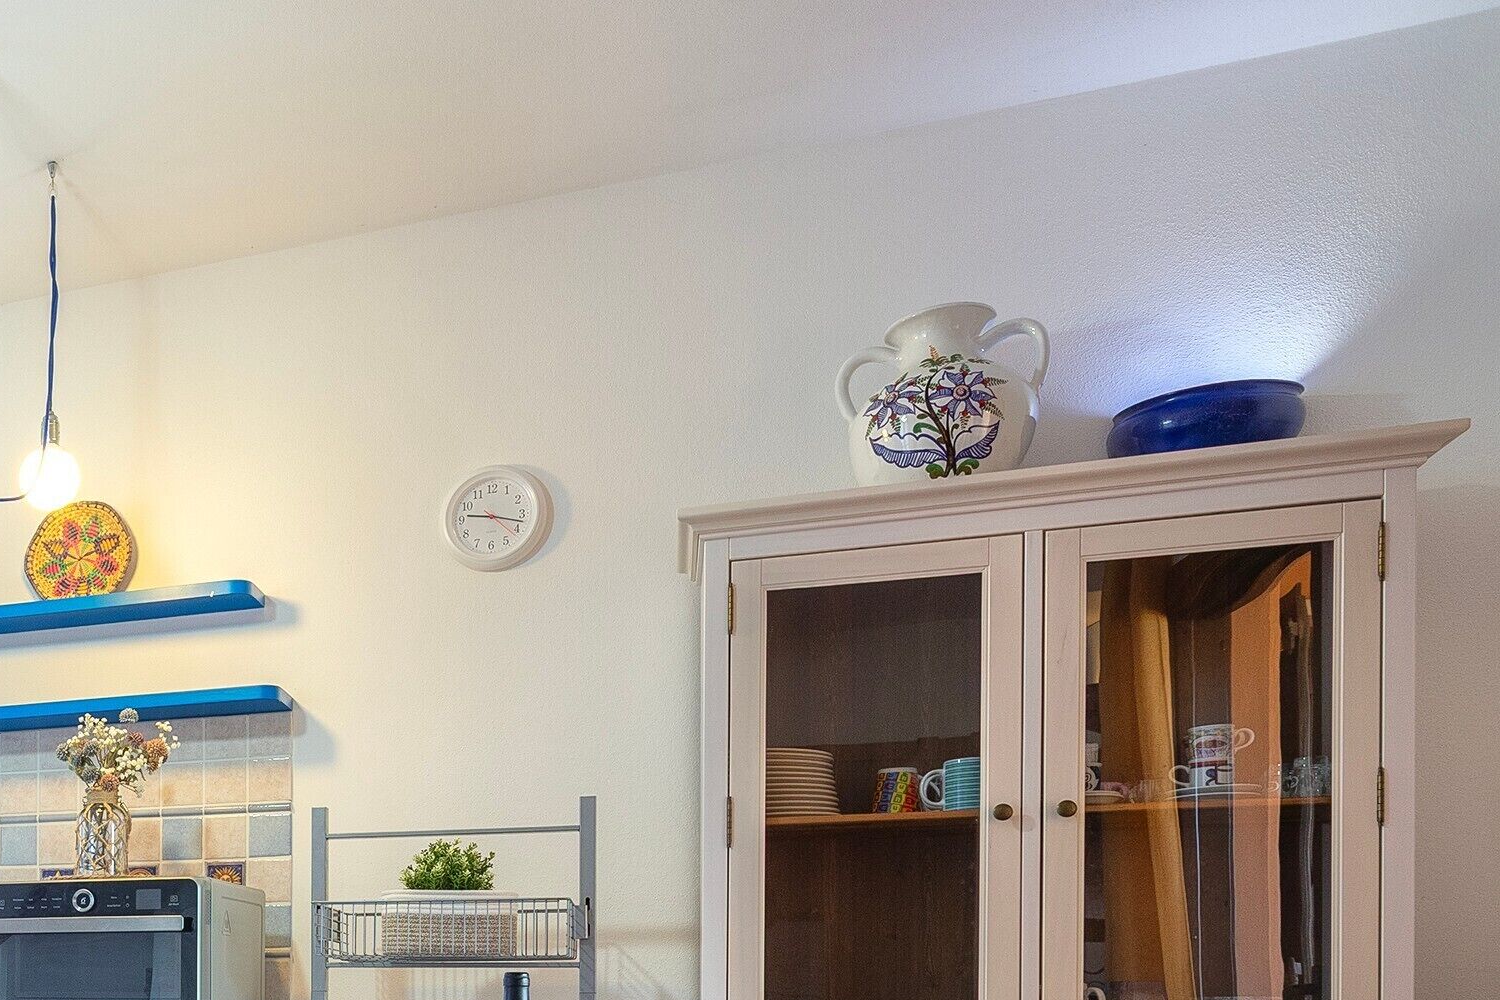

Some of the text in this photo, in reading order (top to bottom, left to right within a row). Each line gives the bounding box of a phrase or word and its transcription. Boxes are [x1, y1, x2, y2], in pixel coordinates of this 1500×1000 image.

[487, 484, 498, 494] 12
[504, 485, 509, 494] 1
[473, 490, 483, 499] 11
[515, 495, 521, 504] 2
[462, 501, 473, 511] 10
[519, 509, 525, 519] 3
[459, 516, 465, 525] 9
[514, 524, 520, 533] 4
[463, 529, 469, 539] 8
[474, 539, 480, 548] 7
[503, 536, 509, 545] 5
[488, 541, 494, 550] 6
